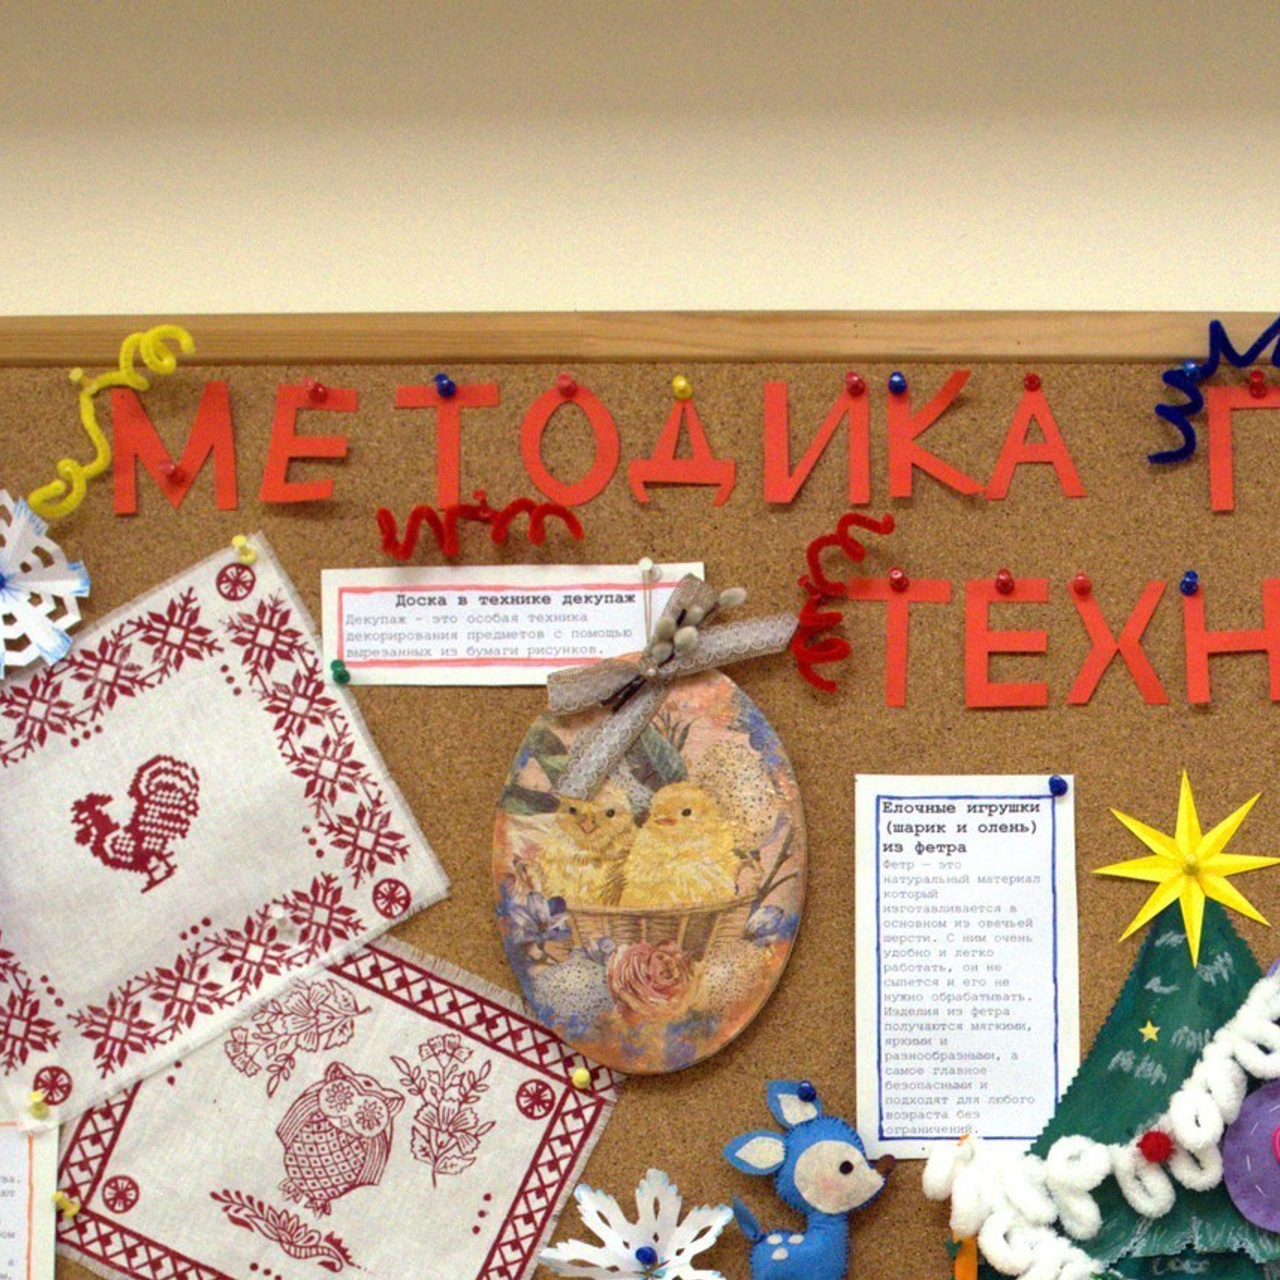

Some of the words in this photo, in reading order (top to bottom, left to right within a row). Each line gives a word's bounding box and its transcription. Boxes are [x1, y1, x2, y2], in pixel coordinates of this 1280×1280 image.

[110, 370, 1086, 515] МЕТОДИКА
[396, 593, 449, 606] Доска
[459, 595, 469, 605] в
[479, 595, 552, 605] технике
[563, 594, 635, 607] декупаж
[345, 613, 406, 626] Декупаж
[433, 615, 459, 623] это
[468, 612, 520, 622] особая
[528, 614, 588, 622] техника
[346, 631, 458, 642] декорирования
[467, 630, 547, 641] предметов
[555, 630, 563, 638] с
[572, 630, 632, 639] помощью
[346, 647, 433, 658] вырезанных
[442, 647, 458, 655] из
[467, 645, 518, 657] бумаги
[527, 646, 604, 656] рисунков.
[883, 801, 958, 813] Елочные
[968, 803, 1040, 816] игрушки
[886, 821, 946, 836] (шарик
[956, 823, 967, 833] и
[977, 821, 1039, 835] олень)
[883, 843, 904, 852] из
[914, 841, 966, 855] фетра
